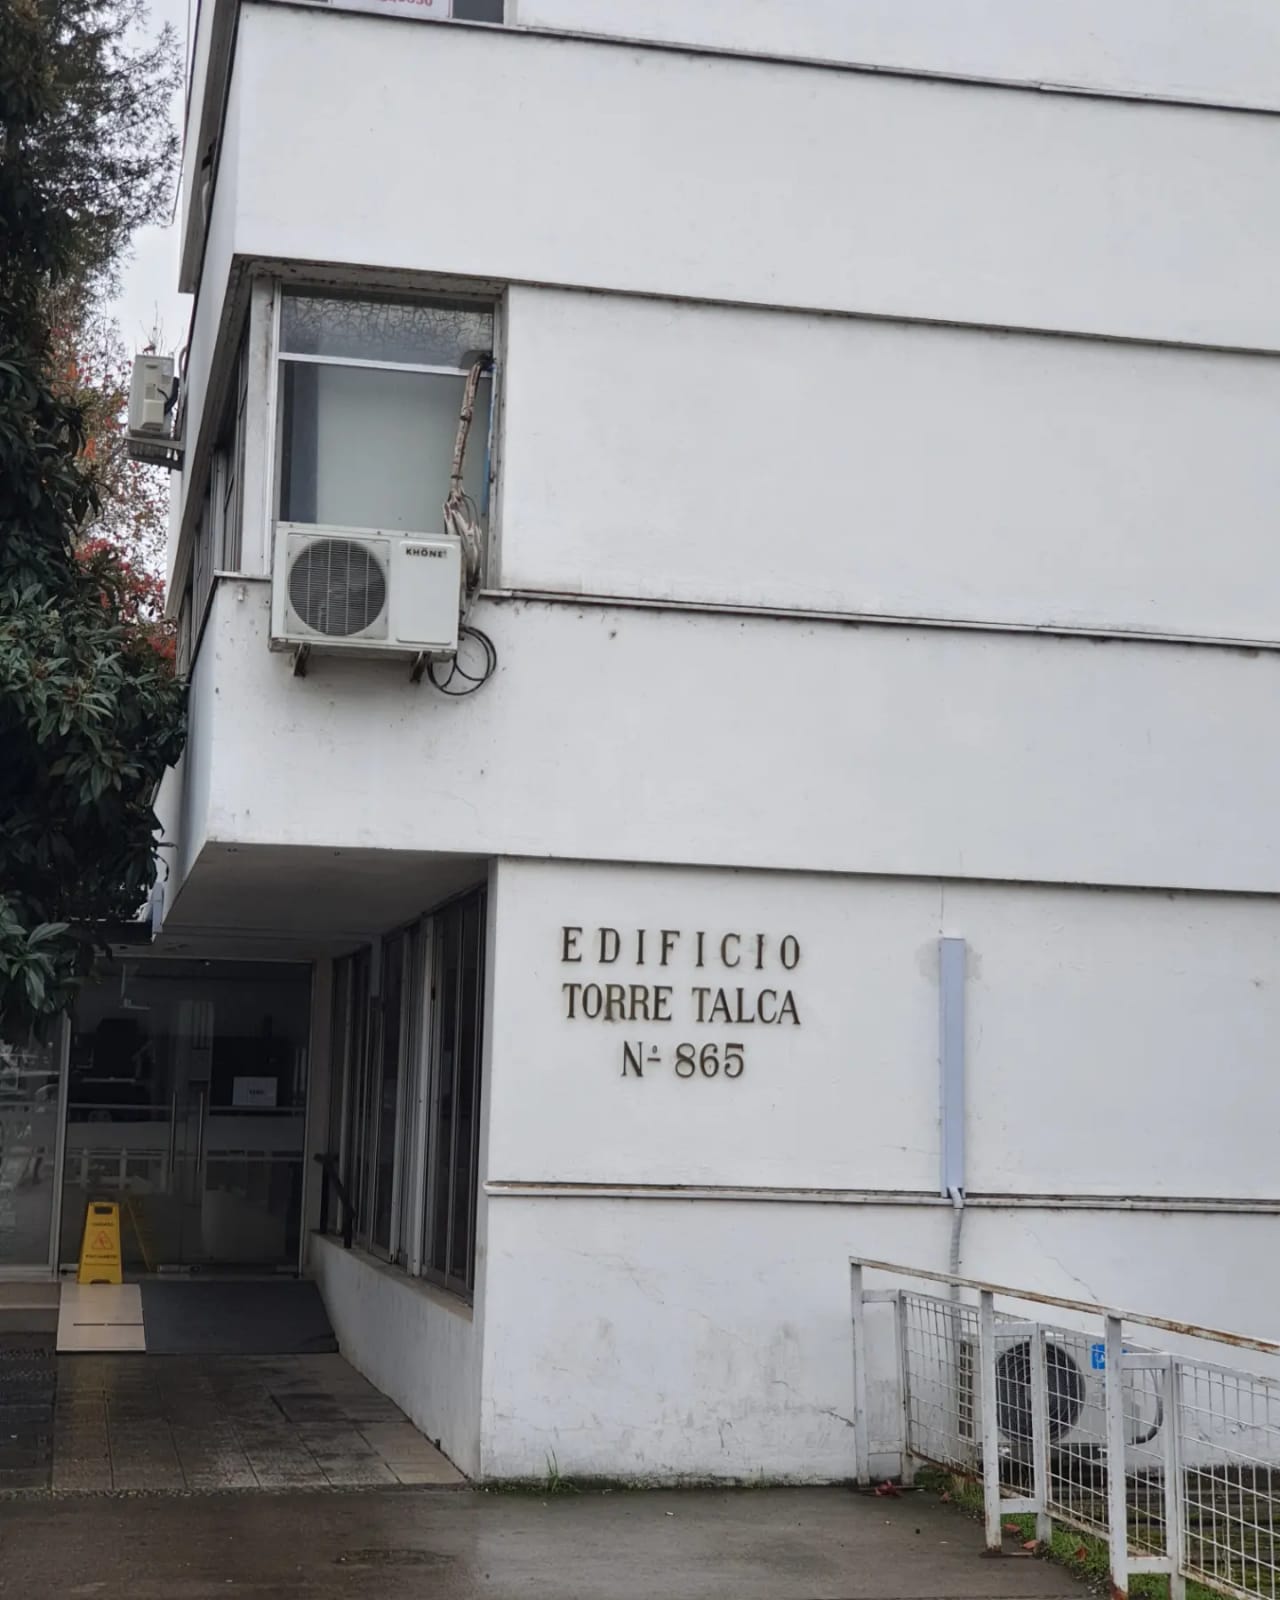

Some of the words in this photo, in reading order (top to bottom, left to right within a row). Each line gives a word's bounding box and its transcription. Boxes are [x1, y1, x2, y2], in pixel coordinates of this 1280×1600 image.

[561, 926, 801, 970] EDIFICIO
[562, 983, 673, 1022] TORRE
[692, 987, 801, 1025] TALCA
[675, 1043, 745, 1078] 865
